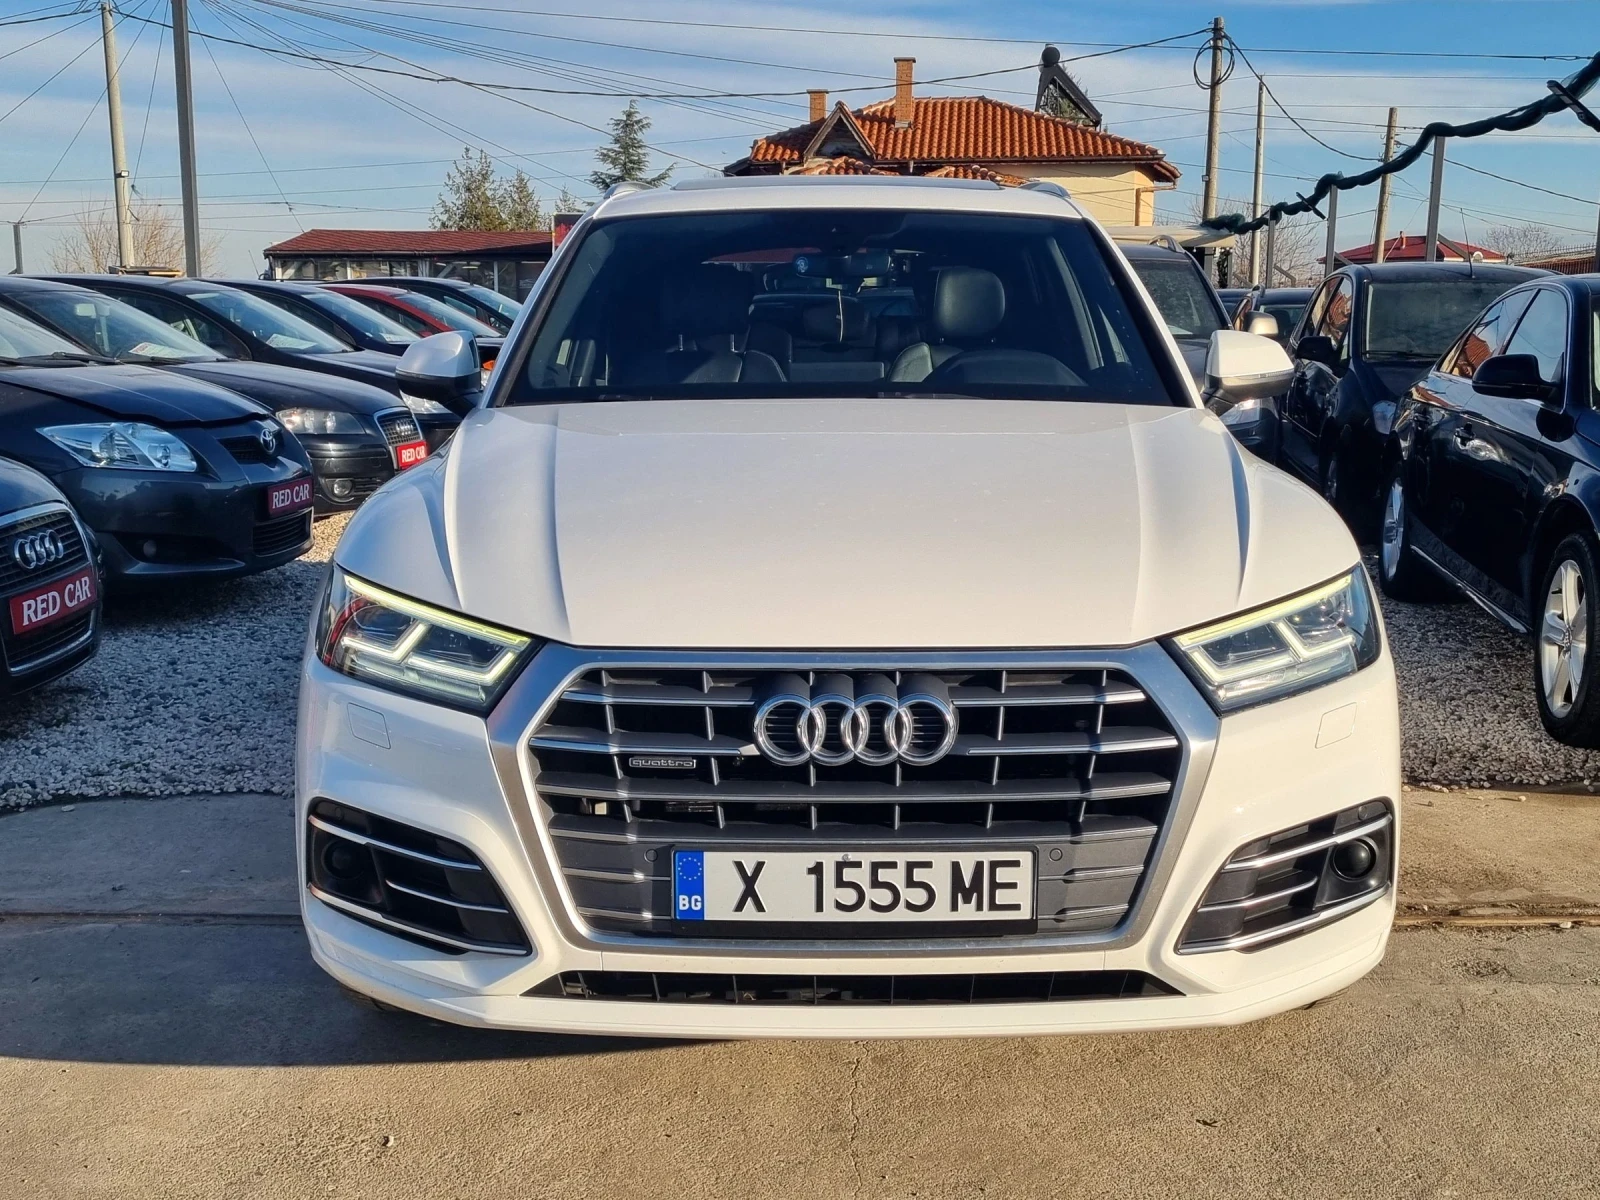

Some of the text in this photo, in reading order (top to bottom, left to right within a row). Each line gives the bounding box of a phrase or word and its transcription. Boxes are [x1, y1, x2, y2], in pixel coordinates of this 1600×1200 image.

[401, 445, 426, 463] RED CAR
[272, 483, 310, 509] RED CAR
[22, 576, 92, 626] RED CAR
[632, 759, 693, 767] quattro
[732, 859, 1022, 913] X 1555 ME
[678, 895, 702, 911] BG
